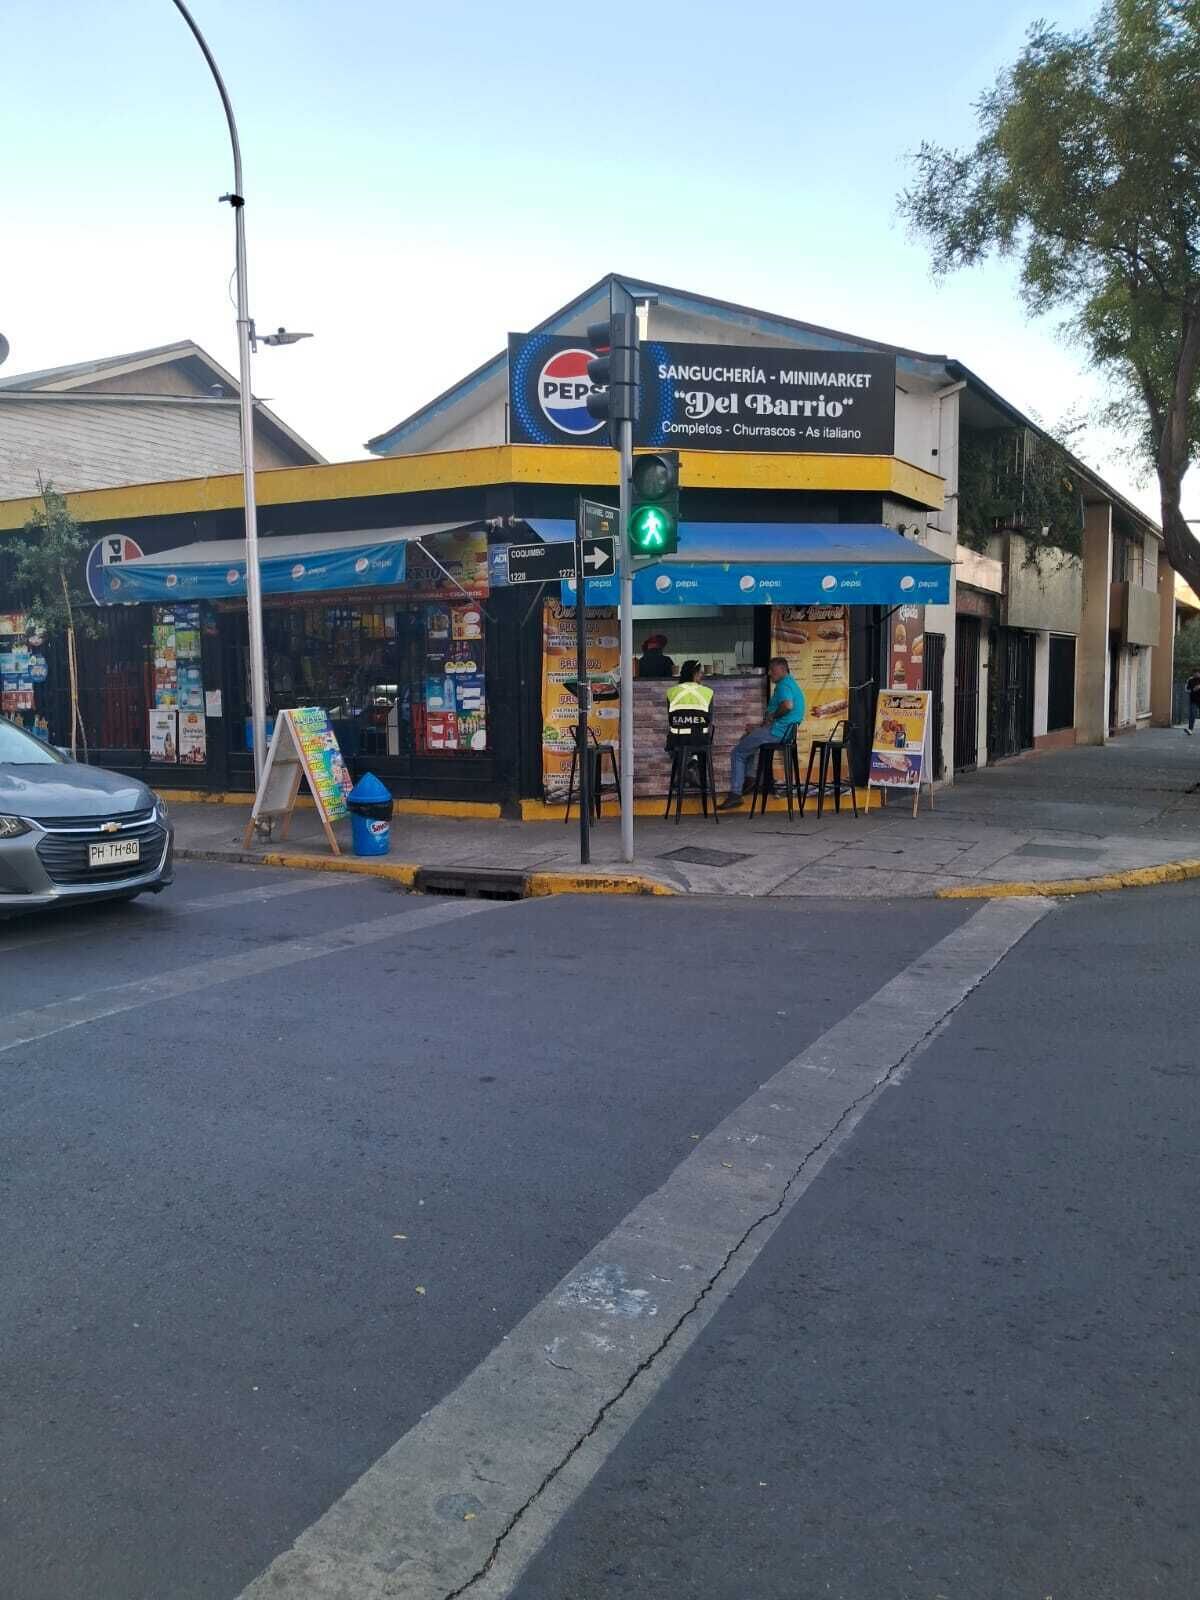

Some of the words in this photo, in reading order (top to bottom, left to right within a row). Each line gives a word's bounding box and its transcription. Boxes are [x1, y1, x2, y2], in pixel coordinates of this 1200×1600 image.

[658, 364, 766, 384] SANGUCHERÍA
[779, 370, 872, 388] MINIMARKET
[543, 382, 610, 400] PEPS
[661, 420, 722, 434] Completos
[733, 424, 796, 437] Churrascos
[806, 427, 820, 438] As
[823, 427, 861, 439] italiano
[511, 548, 546, 559] COQUIMBO
[558, 568, 575, 579] 1272
[588, 580, 612, 589] pepsi
[675, 579, 699, 589] pepsi
[758, 579, 782, 589] pepsi
[839, 579, 862, 589] pepsi
[917, 580, 939, 589] pepsi
